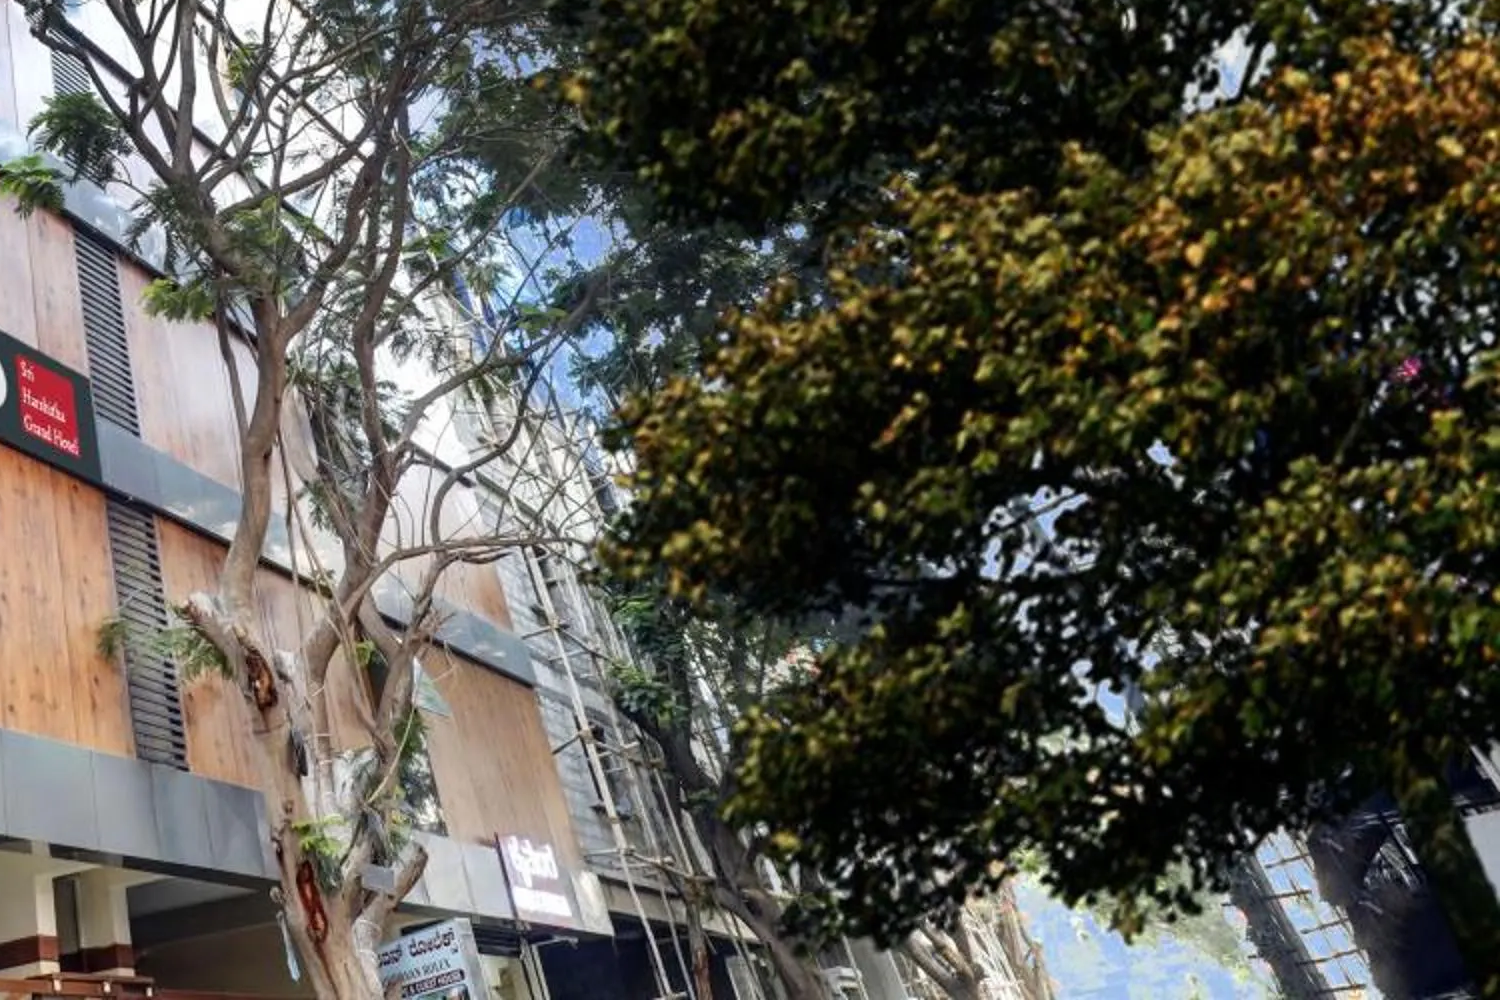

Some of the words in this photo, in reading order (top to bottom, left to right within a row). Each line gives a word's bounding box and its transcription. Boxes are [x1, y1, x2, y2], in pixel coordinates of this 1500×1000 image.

[20, 360, 35, 383] Sri
[23, 413, 52, 441] Grand
[52, 427, 80, 456] Hotel
